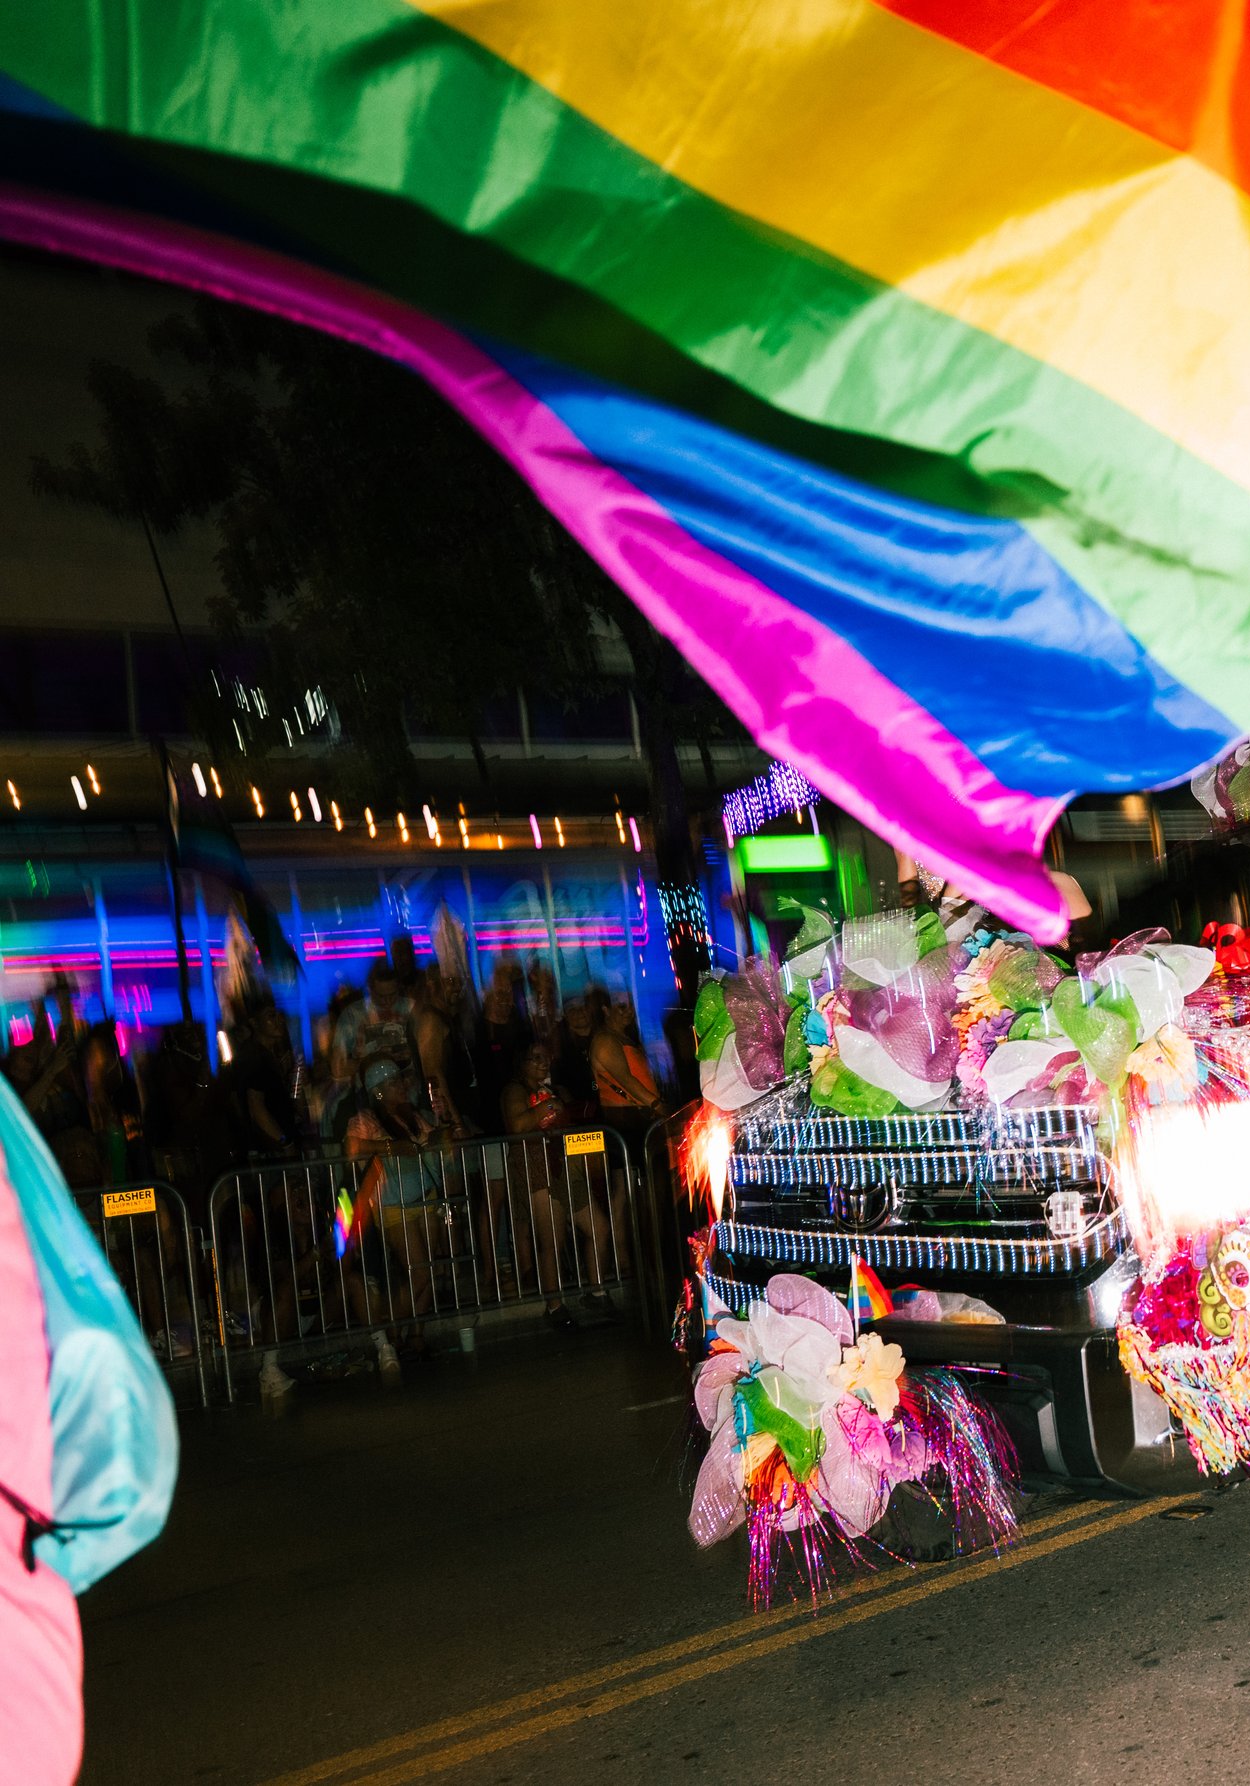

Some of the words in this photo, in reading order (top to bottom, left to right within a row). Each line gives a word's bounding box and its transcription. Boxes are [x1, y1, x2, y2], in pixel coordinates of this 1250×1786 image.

[567, 1132, 602, 1143] FLASHER
[106, 1190, 152, 1204] FLASHER
[107, 1200, 141, 1210] EQUIPMENT
